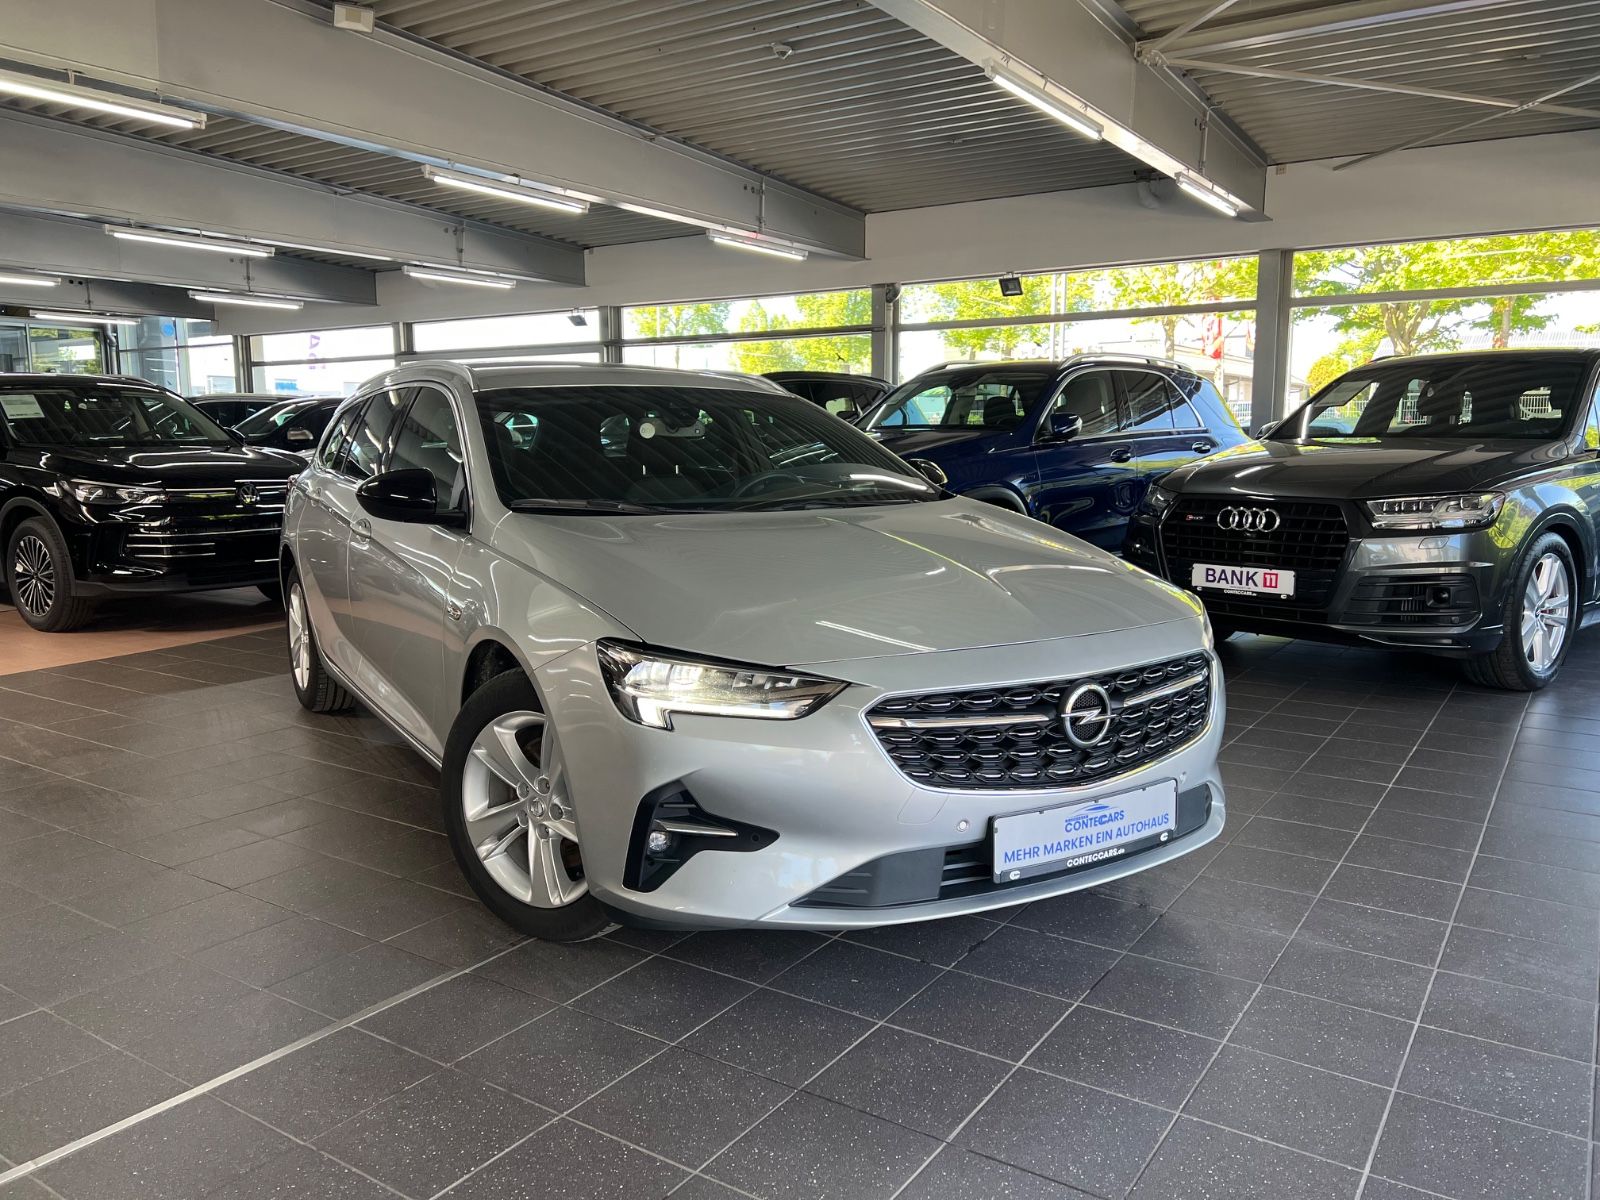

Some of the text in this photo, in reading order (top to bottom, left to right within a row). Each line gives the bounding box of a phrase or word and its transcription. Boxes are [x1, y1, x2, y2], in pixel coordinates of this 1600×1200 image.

[1205, 567, 1259, 587] BANK
[1004, 813, 1169, 864] MEHR MARKEN EIN AUTOHAUS
[1066, 848, 1125, 868] CONTECCARS.de
